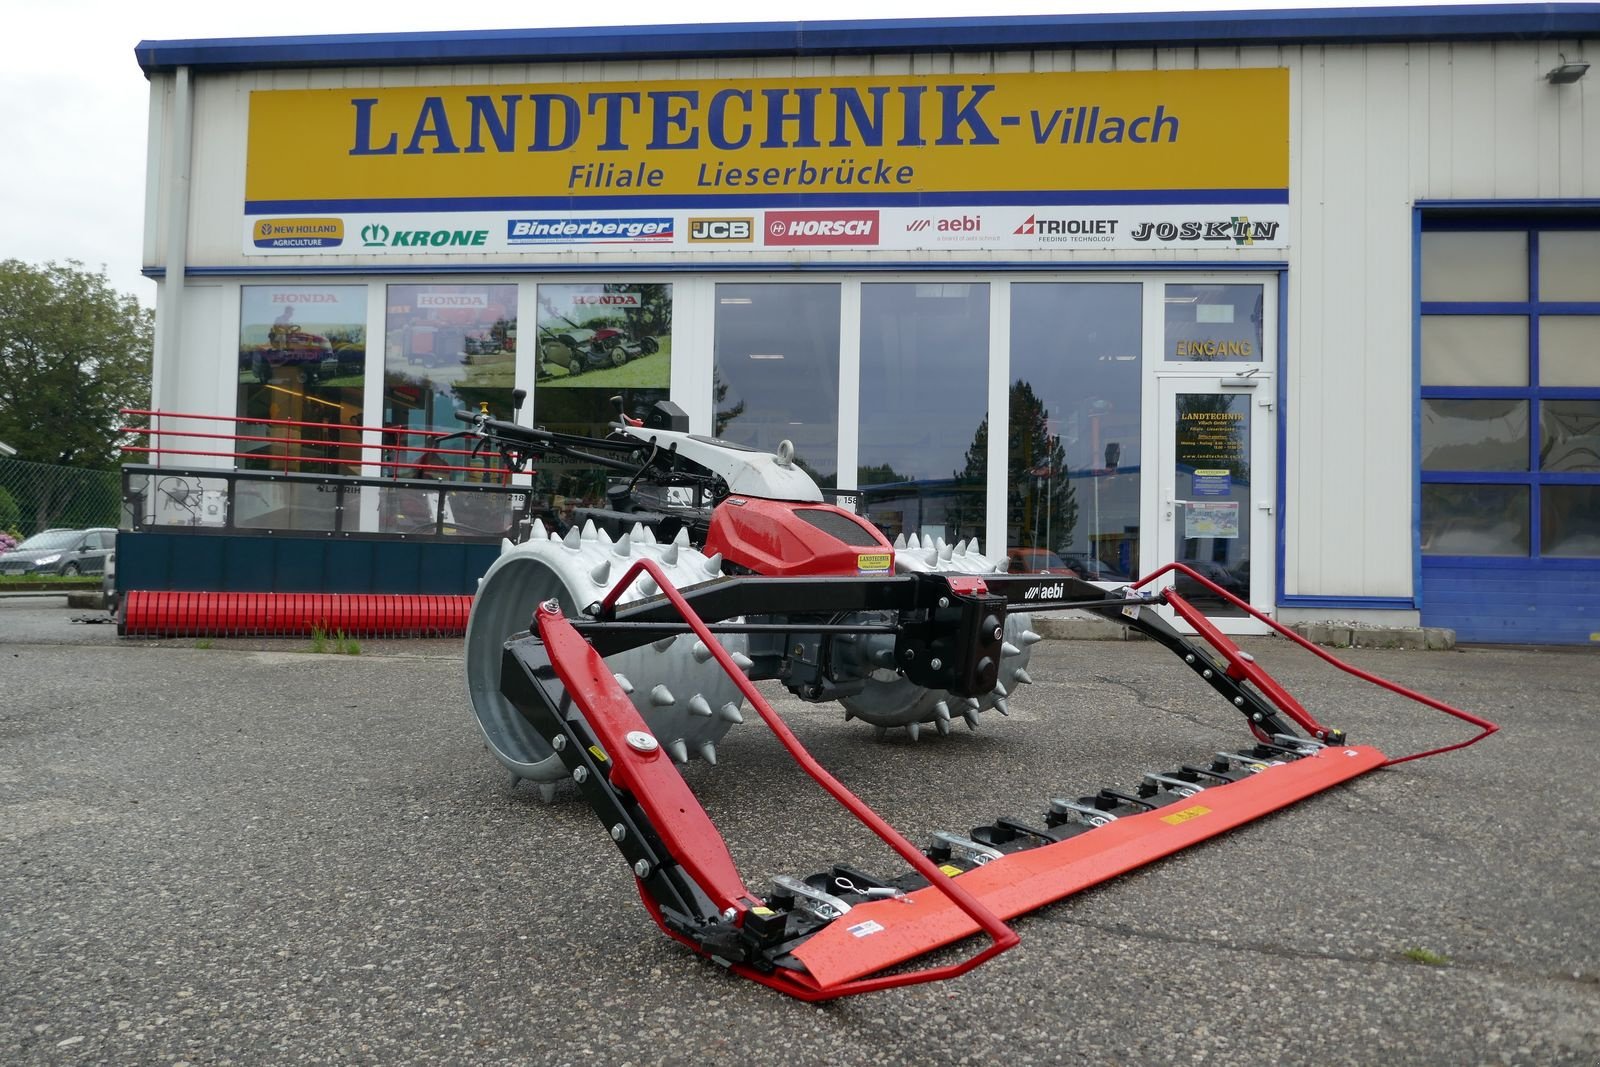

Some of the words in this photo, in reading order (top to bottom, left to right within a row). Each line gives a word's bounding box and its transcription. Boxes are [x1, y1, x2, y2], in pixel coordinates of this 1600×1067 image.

[349, 84, 1180, 156] LANDTECHNIK-Villach
[568, 162, 665, 189] Filiale
[697, 159, 914, 187] Lieserbrücke
[273, 225, 295, 234] NEW
[296, 224, 337, 233] HOLLAND
[512, 222, 670, 237] Binderberger
[692, 222, 750, 239] JCB
[788, 220, 873, 236] HORSCH
[937, 215, 981, 231] aebi
[1036, 219, 1118, 234] TRIOLIET
[1131, 221, 1280, 241] JOSKIN
[272, 238, 322, 247] AGRICULTURE
[391, 229, 490, 247] KRONE
[272, 294, 339, 304] HONDA
[421, 296, 485, 306] HONDA
[571, 295, 639, 305] HONDA
[1176, 339, 1253, 357] EINGANG
[1041, 582, 1065, 599] aebi
